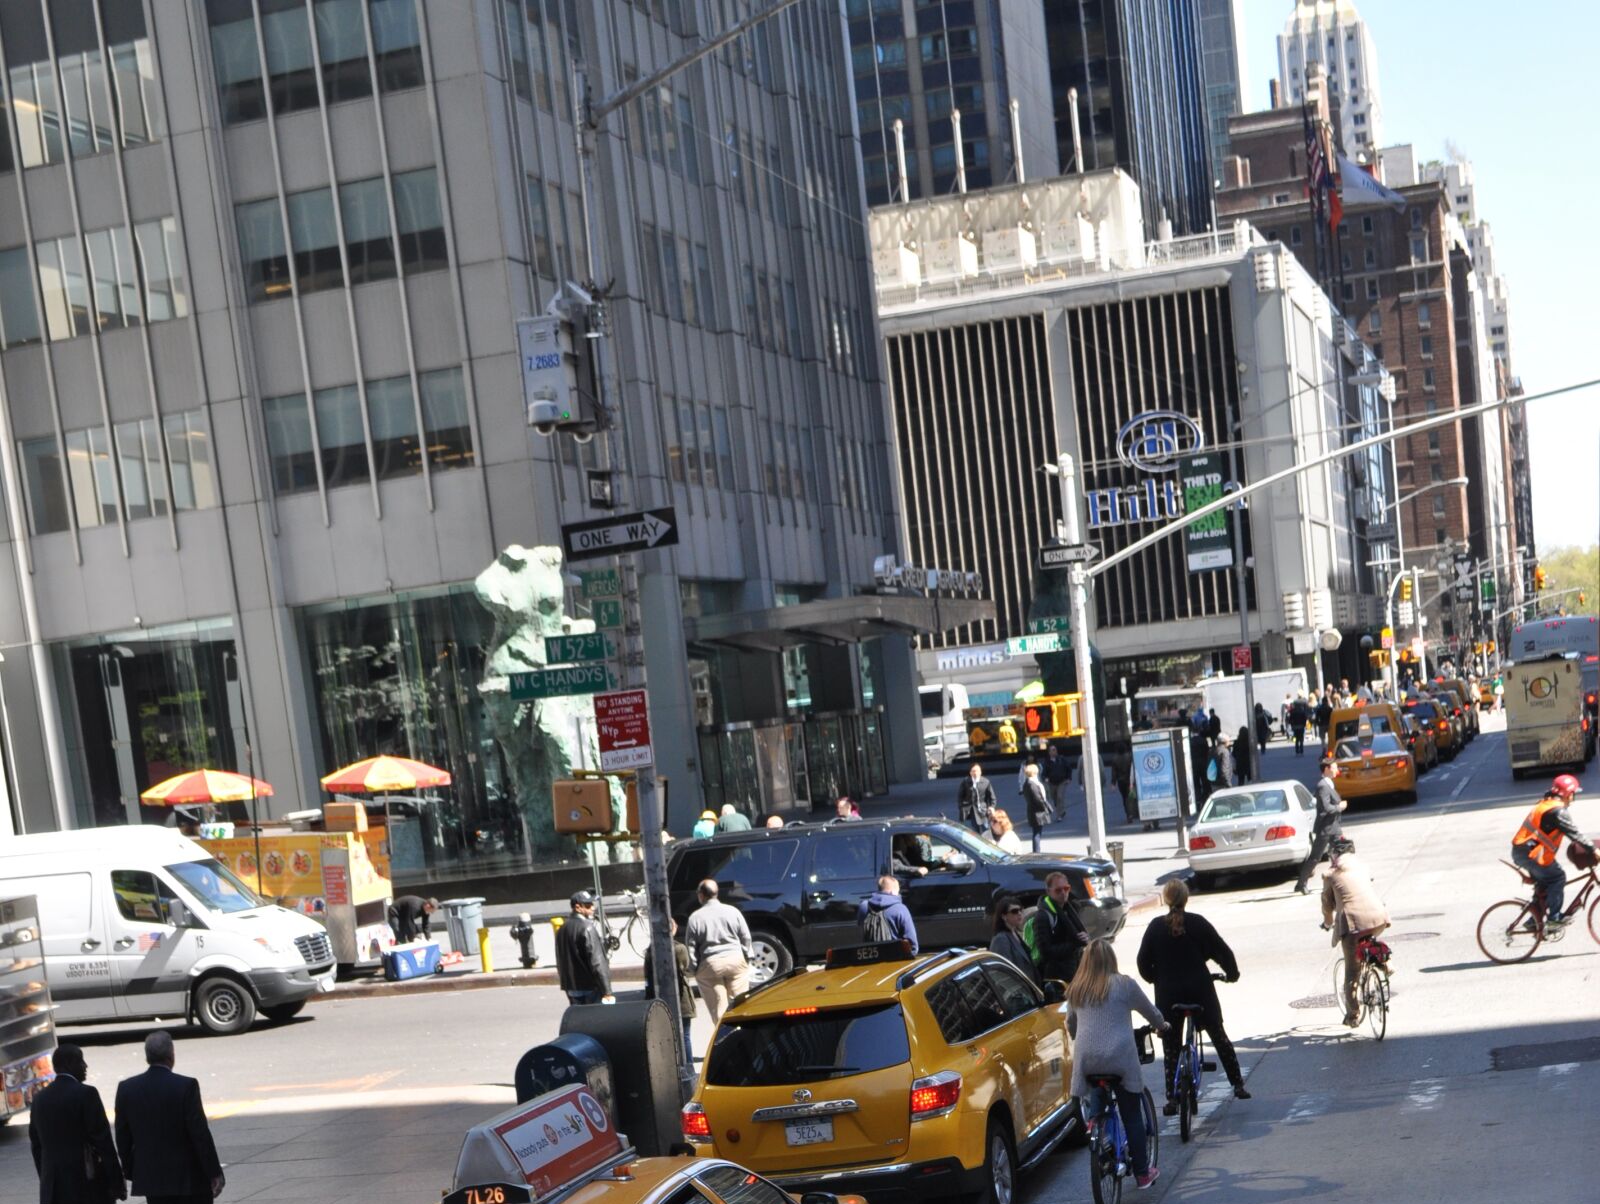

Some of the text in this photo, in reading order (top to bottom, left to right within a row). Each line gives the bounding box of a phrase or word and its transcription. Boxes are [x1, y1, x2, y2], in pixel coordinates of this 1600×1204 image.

[1184, 473, 1222, 489] THE TD
[580, 522, 660, 548] ONE WAY
[1049, 549, 1093, 561] ONE WAY
[600, 604, 608, 625] 6
[1029, 622, 1038, 633] W
[1043, 619, 1057, 632] 52
[550, 636, 601, 661] W 52 ST
[513, 675, 526, 690] W
[530, 673, 540, 688] C
[547, 686, 572, 696] PLACE
[597, 695, 643, 709] NO STANDING
[608, 706, 634, 715] ANYTIME
[604, 752, 648, 767] 3 HOUR LIMIT
[195, 936, 205, 949] 15
[856, 947, 879, 960] 5E25
[515, 1142, 538, 1159] Nobody
[536, 1138, 550, 1152] puts
[561, 1126, 573, 1137] the
